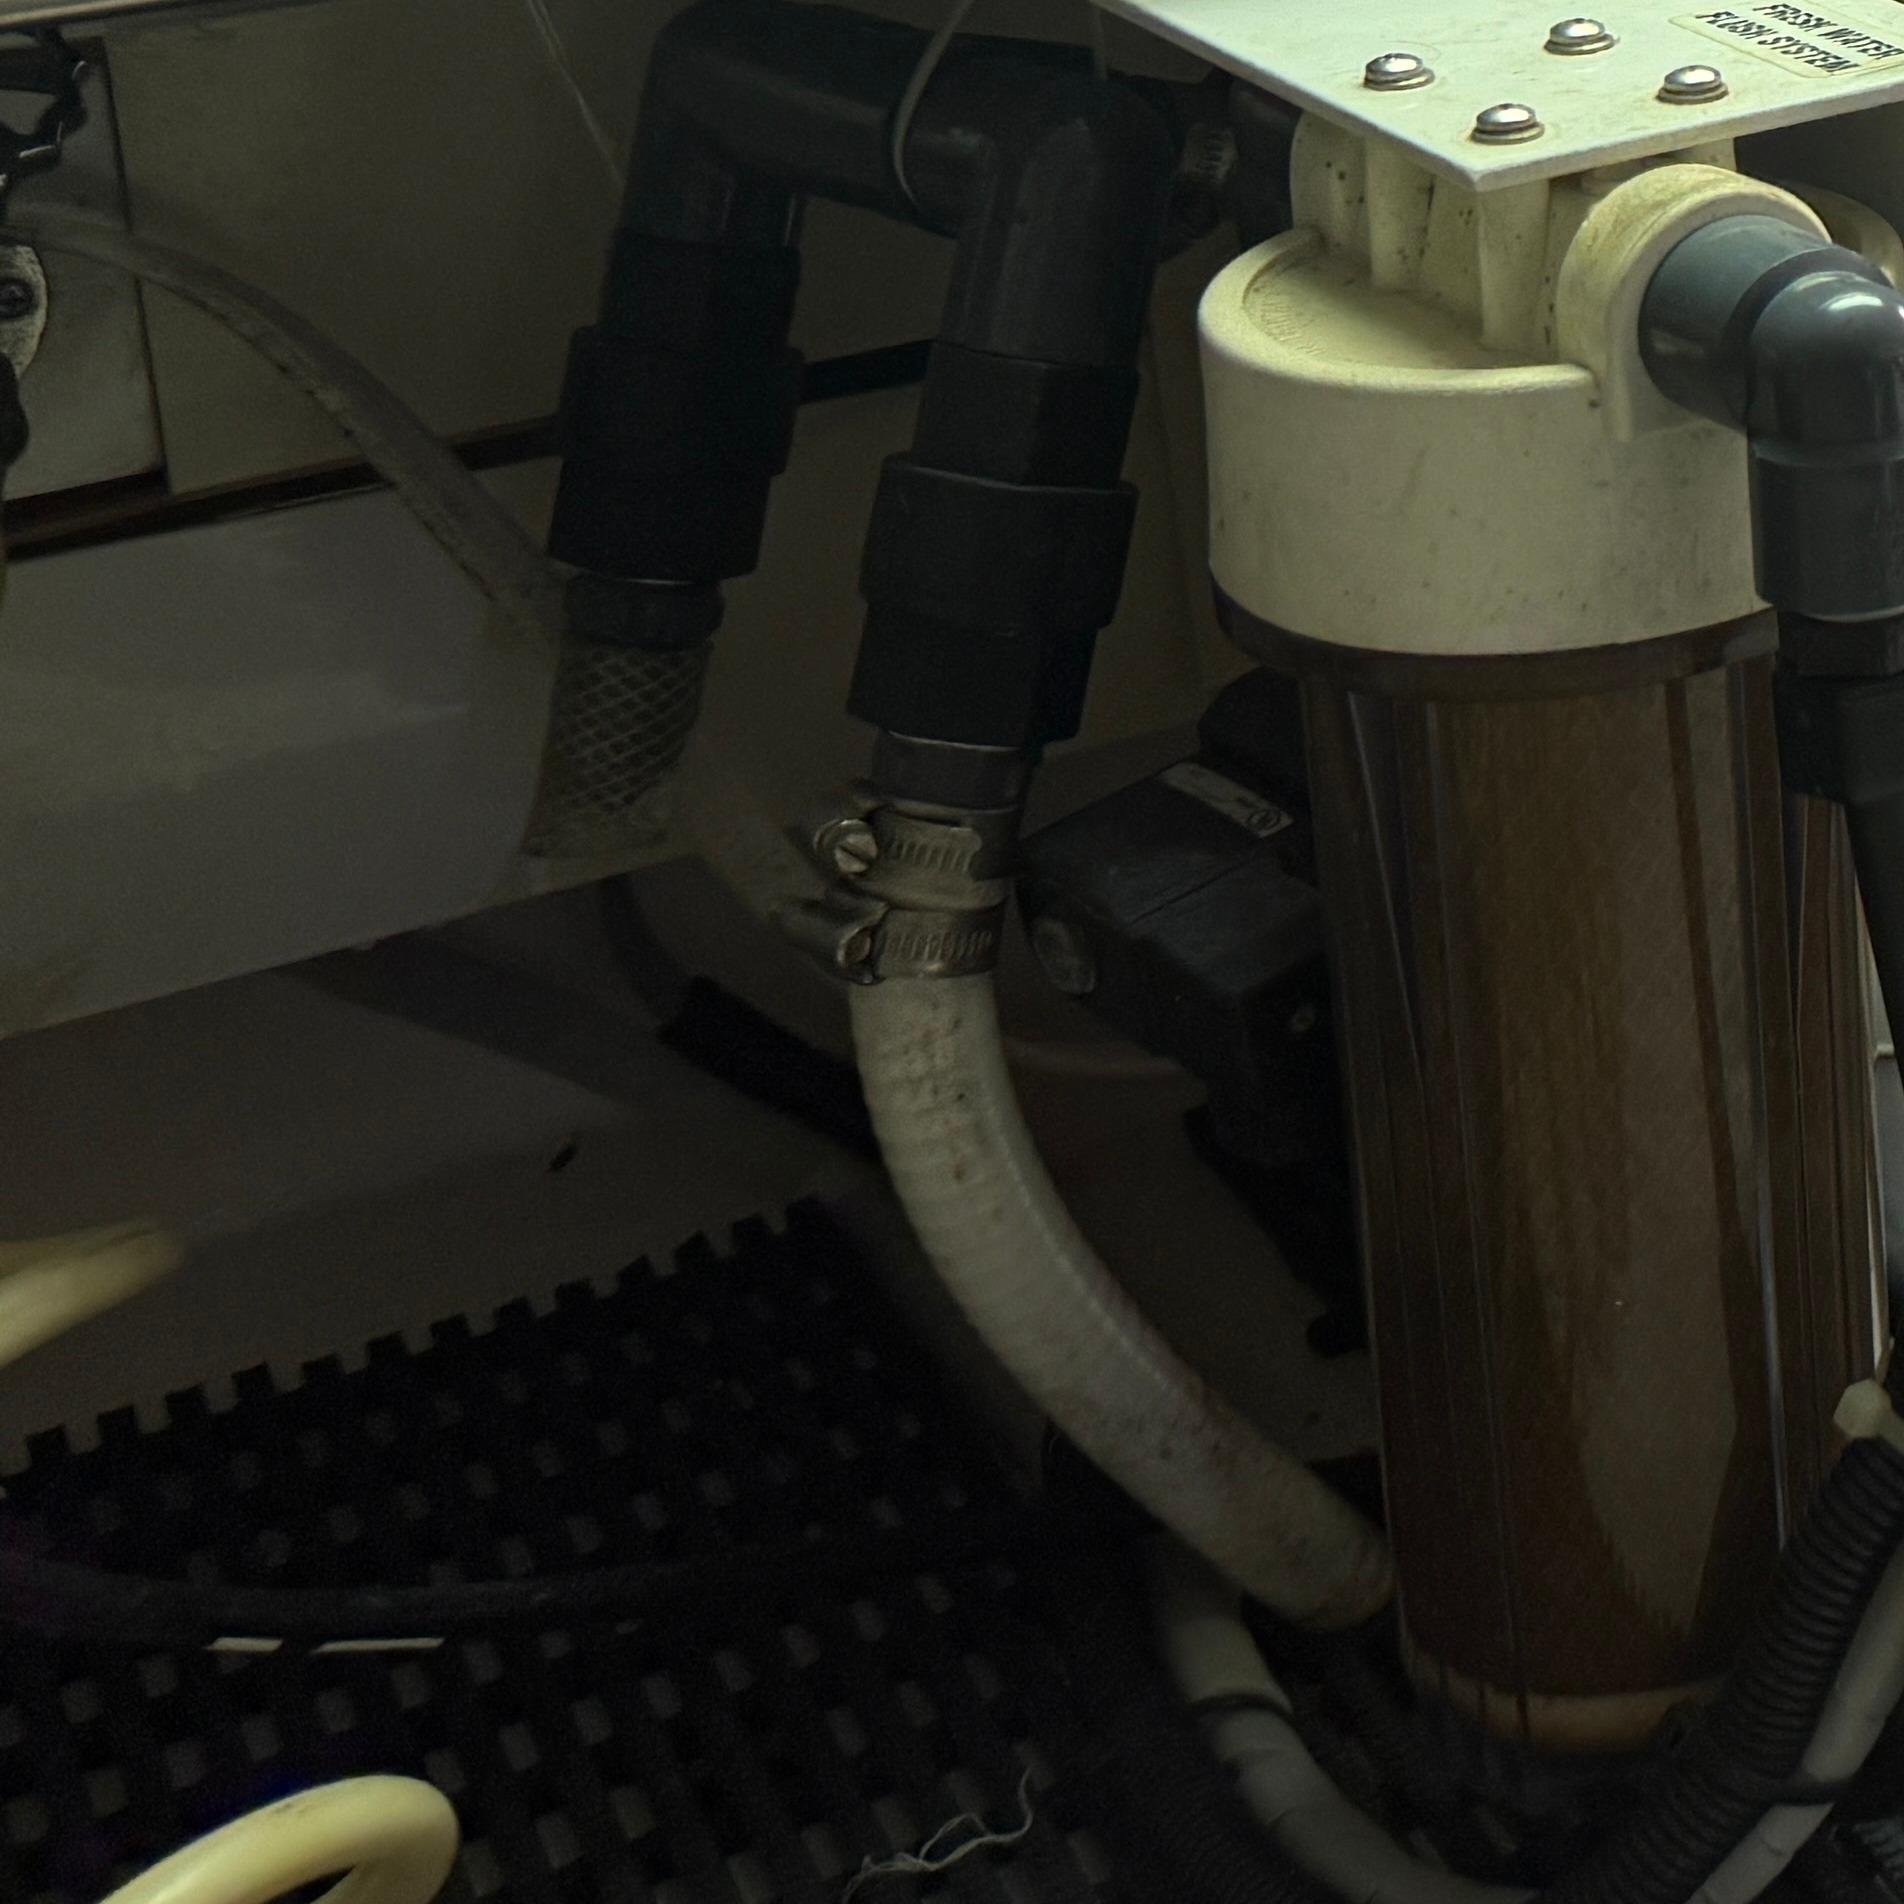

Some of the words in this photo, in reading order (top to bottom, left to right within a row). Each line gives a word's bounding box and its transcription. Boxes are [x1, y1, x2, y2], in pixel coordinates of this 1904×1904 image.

[1752, 3, 1838, 33] FRESH
[1695, 10, 1779, 40] FLUSH
[1757, 35, 1860, 73] SYSTEM
